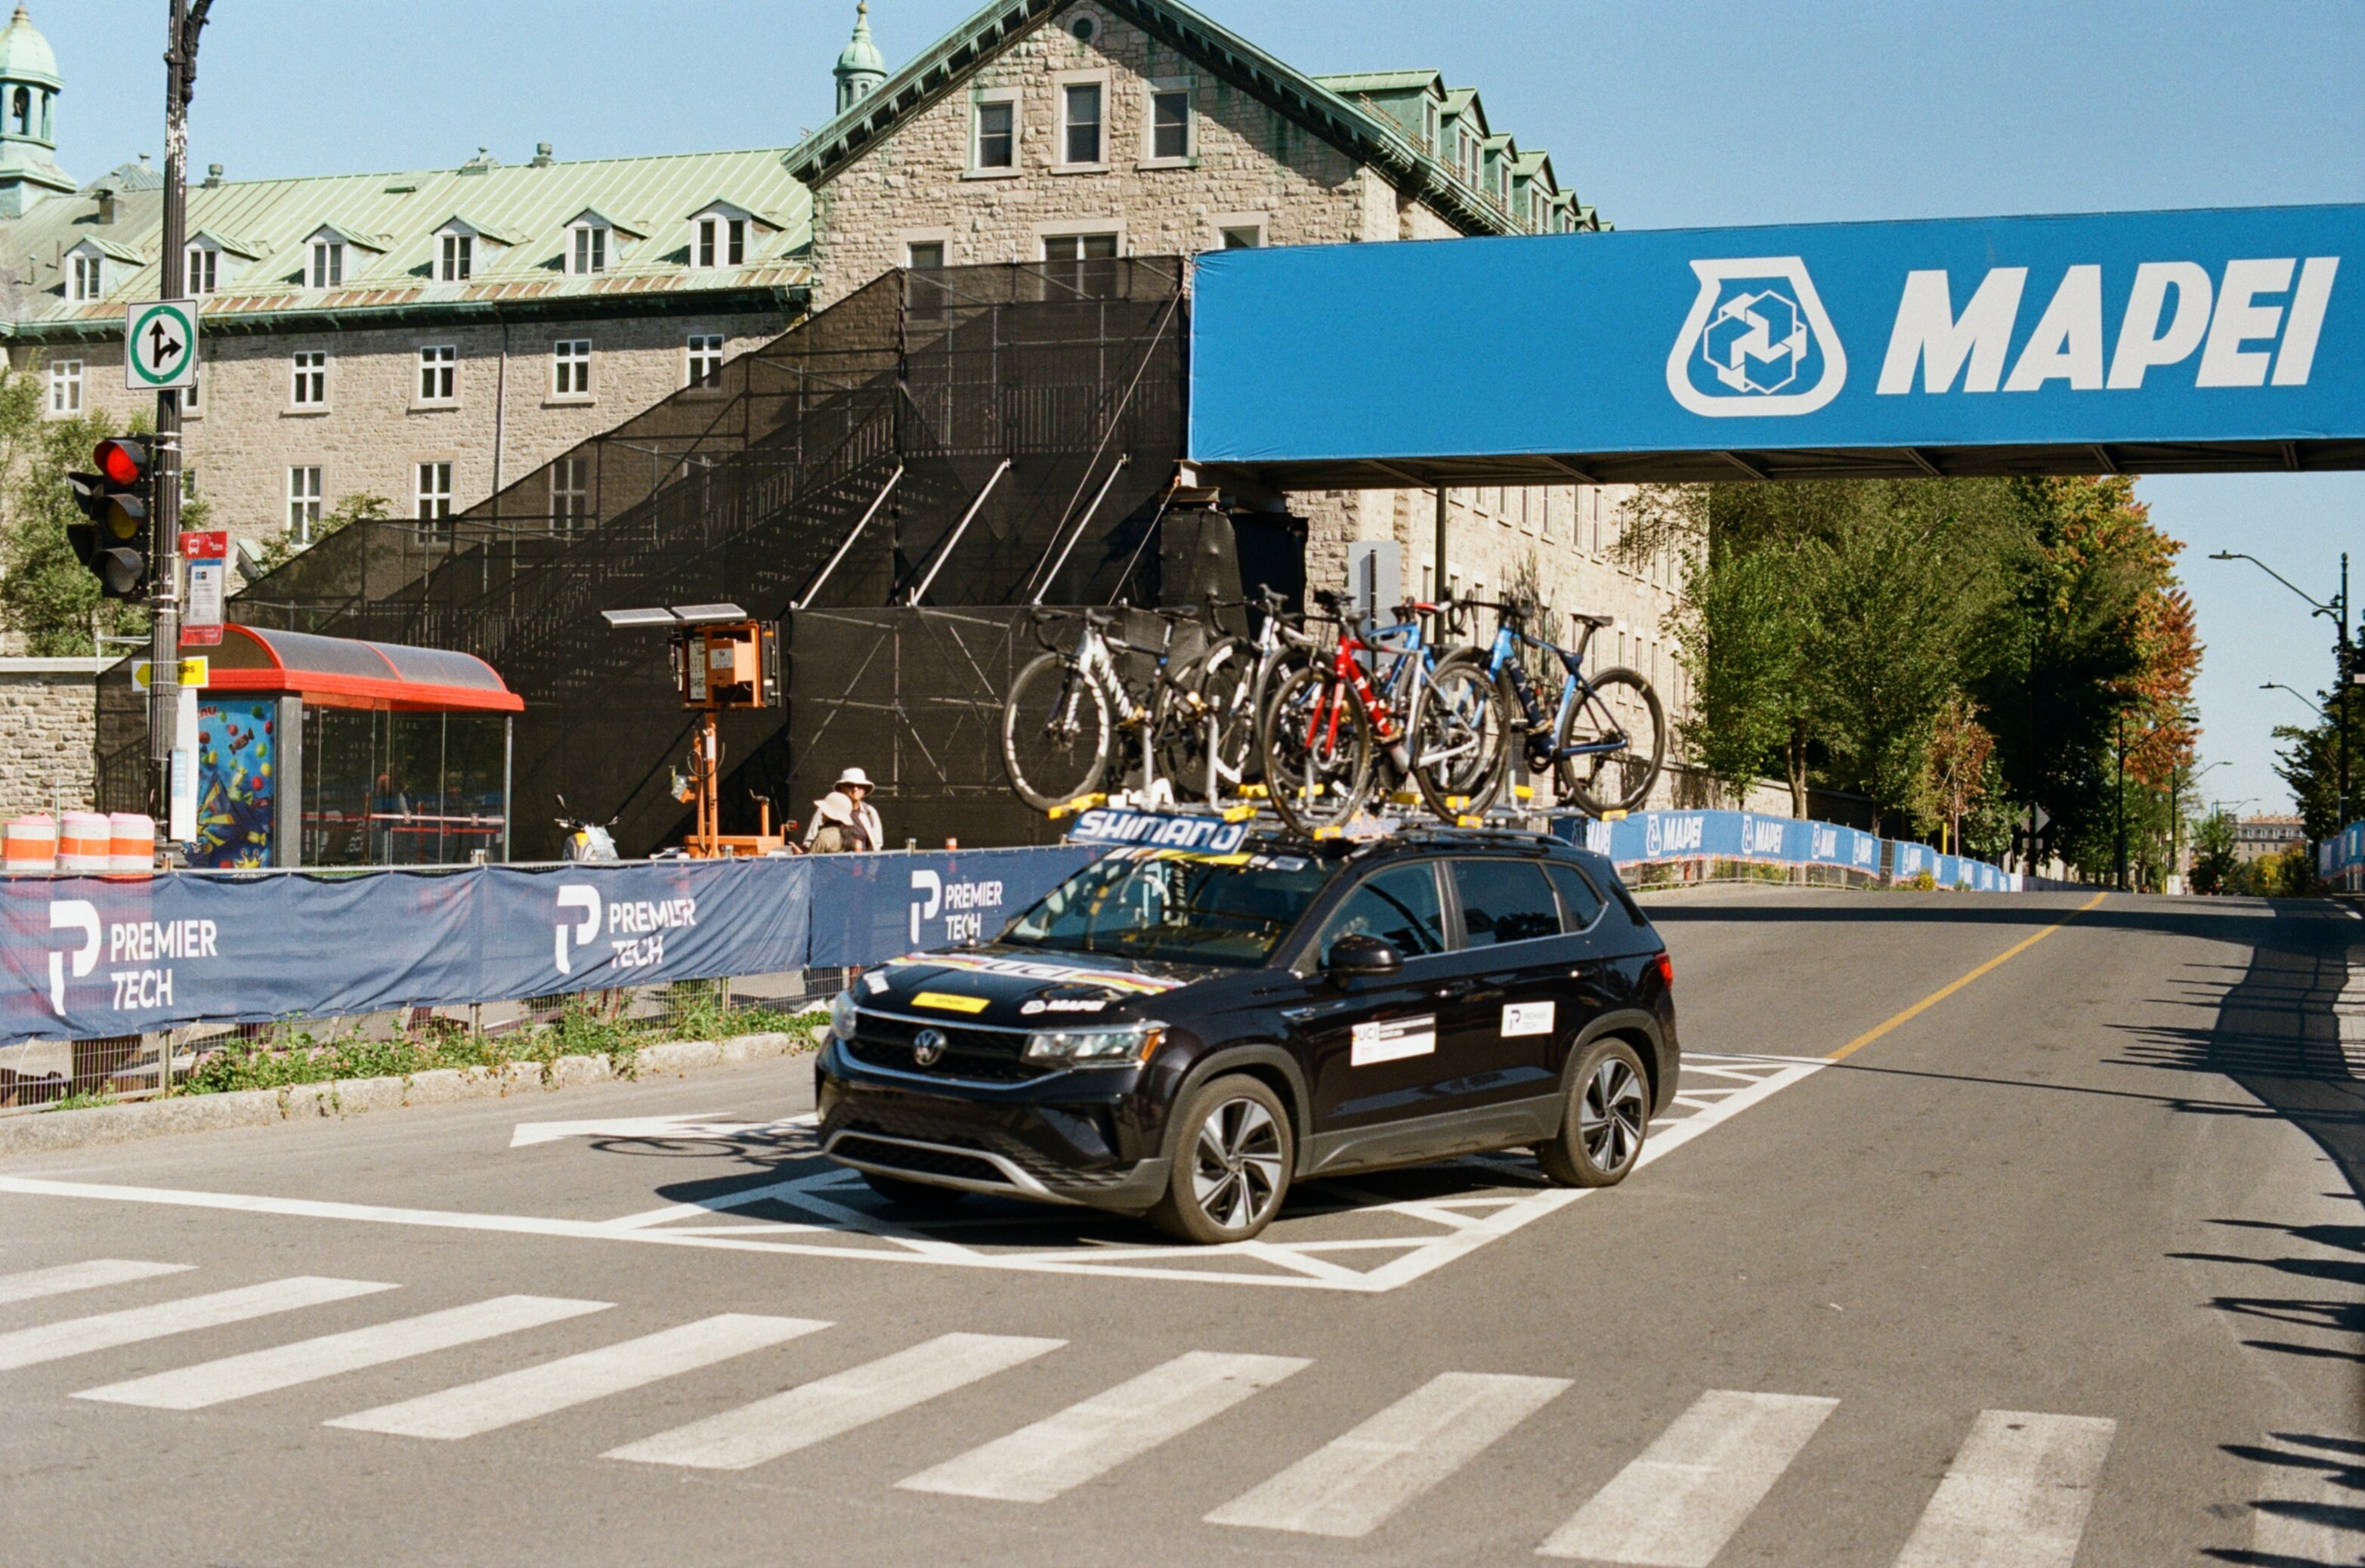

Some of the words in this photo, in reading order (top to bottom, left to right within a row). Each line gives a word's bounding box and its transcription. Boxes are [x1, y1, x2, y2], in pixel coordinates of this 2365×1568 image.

[1875, 256, 2341, 396] MAPEI
[1074, 810, 1244, 851] SHIMANO
[1663, 816, 1705, 851] MAPEI
[1754, 820, 1784, 854] MAPEI
[945, 880, 1003, 911] PREMIER
[608, 898, 697, 934] PREMIER
[945, 914, 982, 941] TECH
[110, 919, 218, 962] PREMIER
[611, 935, 664, 969] TECH
[989, 960, 1068, 978] UCI
[110, 967, 173, 1010] TECH
[1357, 1026, 1377, 1041] UCI
